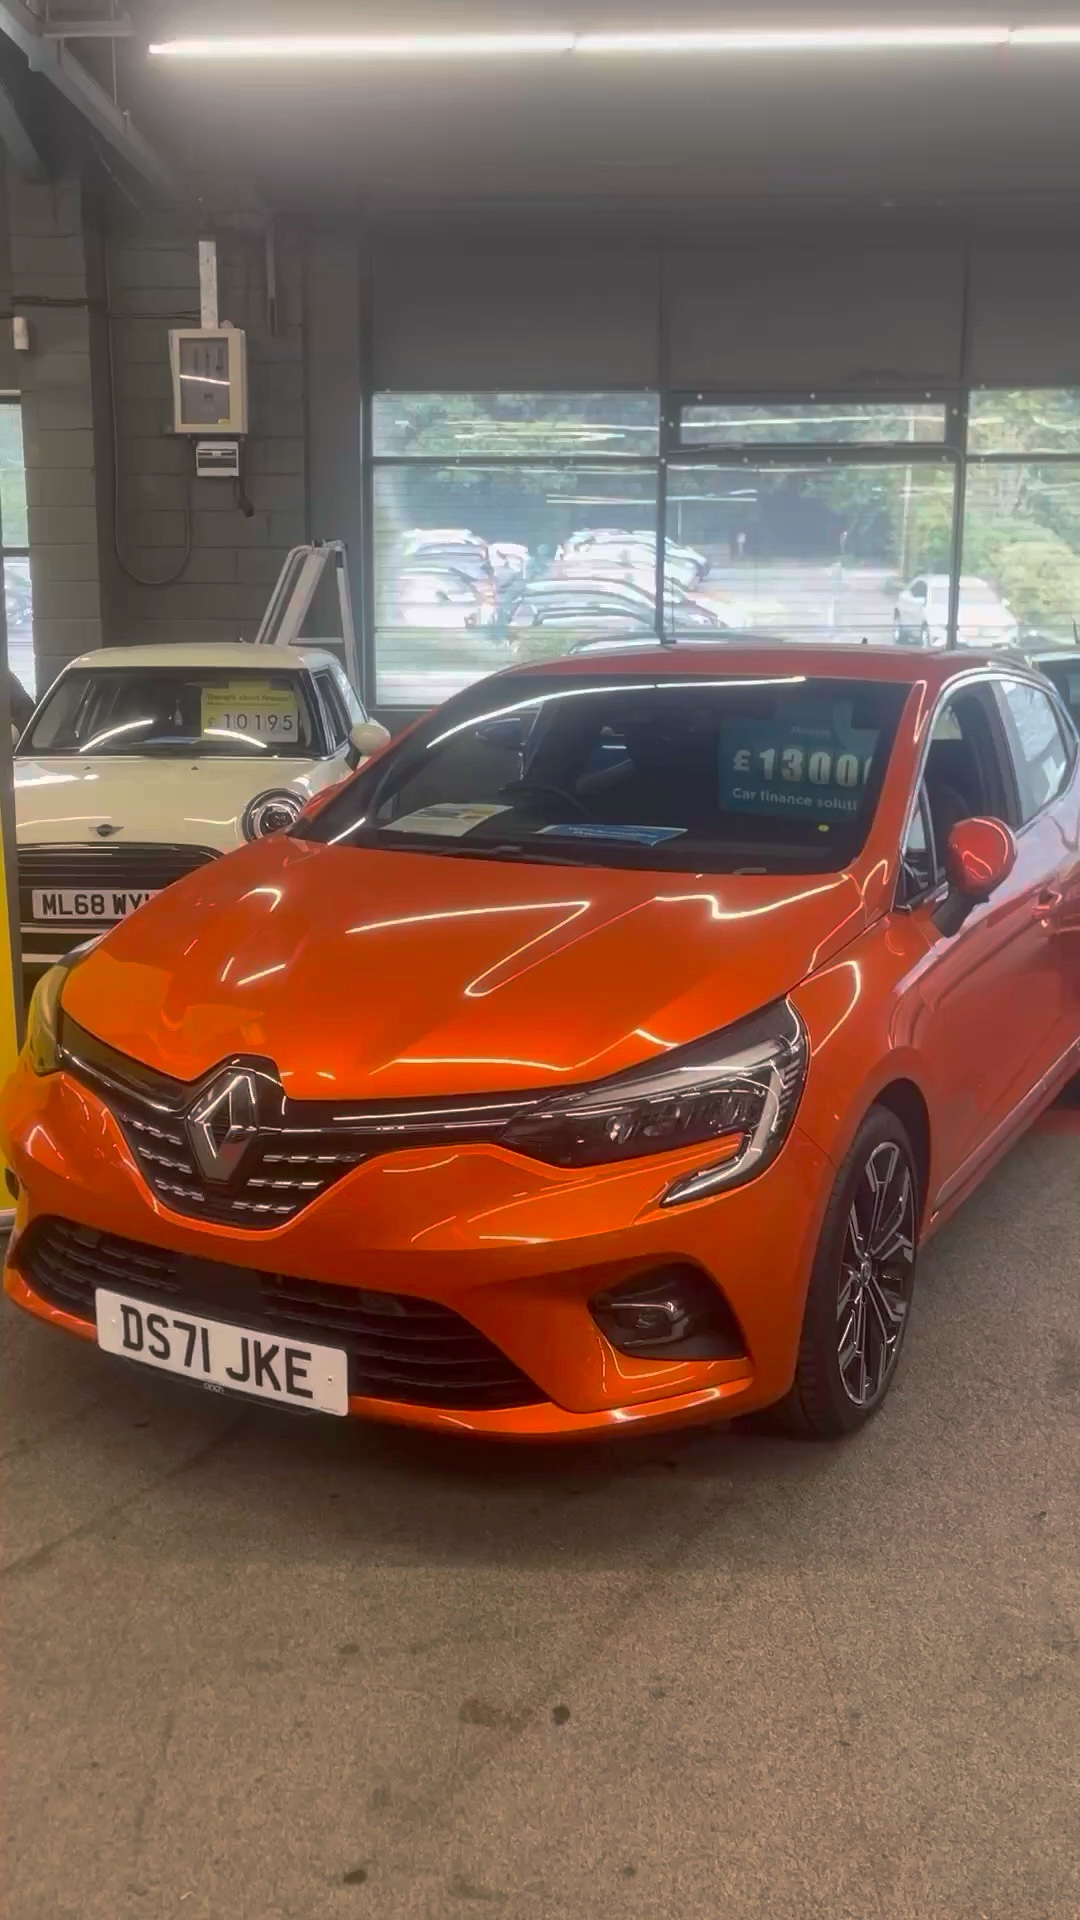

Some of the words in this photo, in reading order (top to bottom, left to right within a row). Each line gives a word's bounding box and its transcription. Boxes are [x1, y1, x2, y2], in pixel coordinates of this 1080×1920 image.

[223, 713, 293, 731] 10195
[732, 787, 757, 800] Car
[760, 790, 813, 807] finance
[41, 893, 106, 916] ML68
[112, 893, 151, 916] WY
[120, 1303, 212, 1374] DS71
[225, 1337, 314, 1399] JKE
